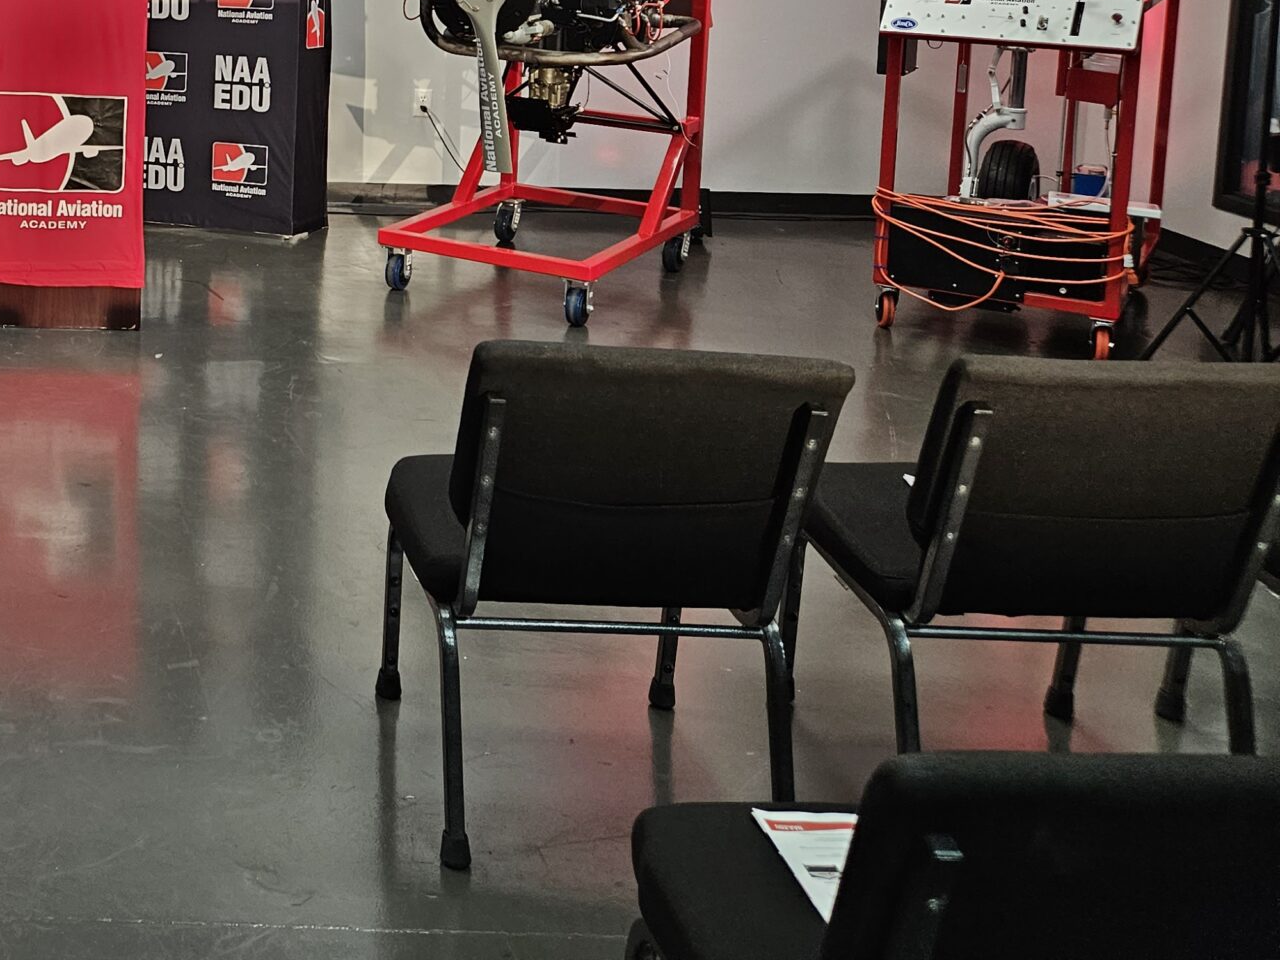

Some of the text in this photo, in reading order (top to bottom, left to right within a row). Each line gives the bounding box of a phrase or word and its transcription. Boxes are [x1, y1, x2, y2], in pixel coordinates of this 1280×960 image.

[218, 10, 272, 20] National Aviation
[215, 55, 270, 82] NAA
[160, 93, 186, 102] Aviation
[214, 84, 270, 112] EDU
[488, 72, 502, 138] ACADEMY
[144, 136, 184, 164] AA
[482, 105, 497, 172] National
[143, 164, 184, 192] DU
[212, 183, 266, 196] National Aviation
[56, 200, 122, 218] Aviation
[20, 220, 87, 229] ACADEMY
